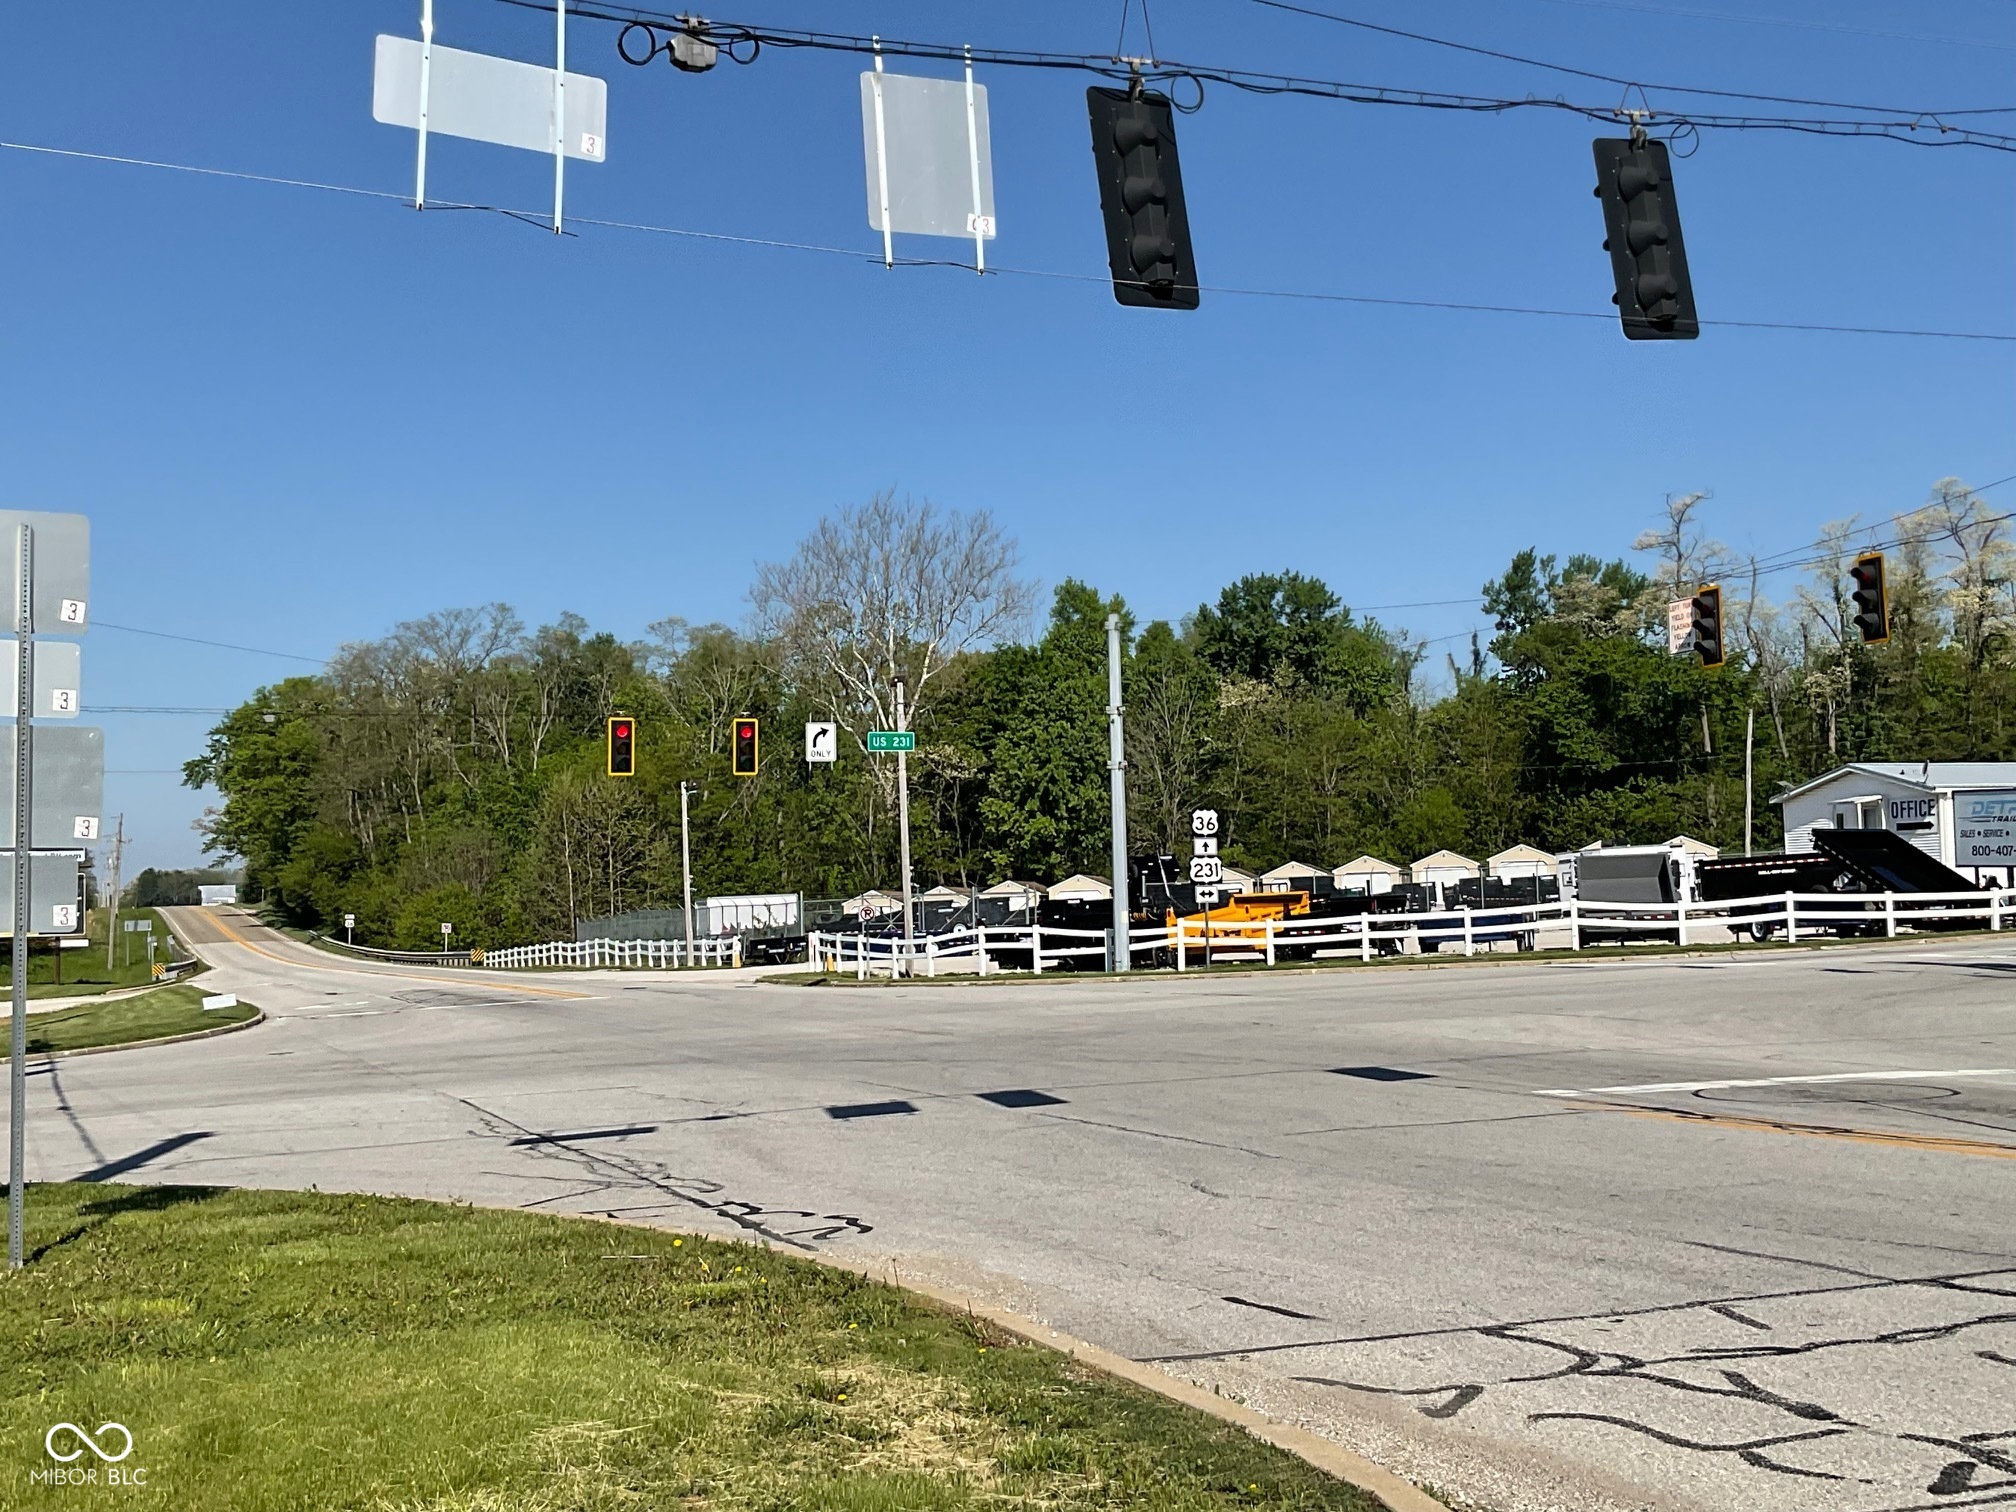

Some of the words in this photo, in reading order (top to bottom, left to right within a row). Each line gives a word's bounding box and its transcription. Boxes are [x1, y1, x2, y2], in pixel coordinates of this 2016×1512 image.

[587, 137, 595, 154] 3
[68, 603, 77, 621] 3
[60, 692, 69, 709] 3
[873, 737, 886, 747] US
[893, 737, 910, 747] 231
[1891, 799, 1935, 819] OFFICE
[82, 820, 91, 837] 3
[1195, 817, 1215, 831] 36
[1960, 829, 1975, 838] SALES
[1983, 829, 2003, 838] SERVICE
[1194, 863, 1219, 878] 231
[60, 907, 69, 925] 3
